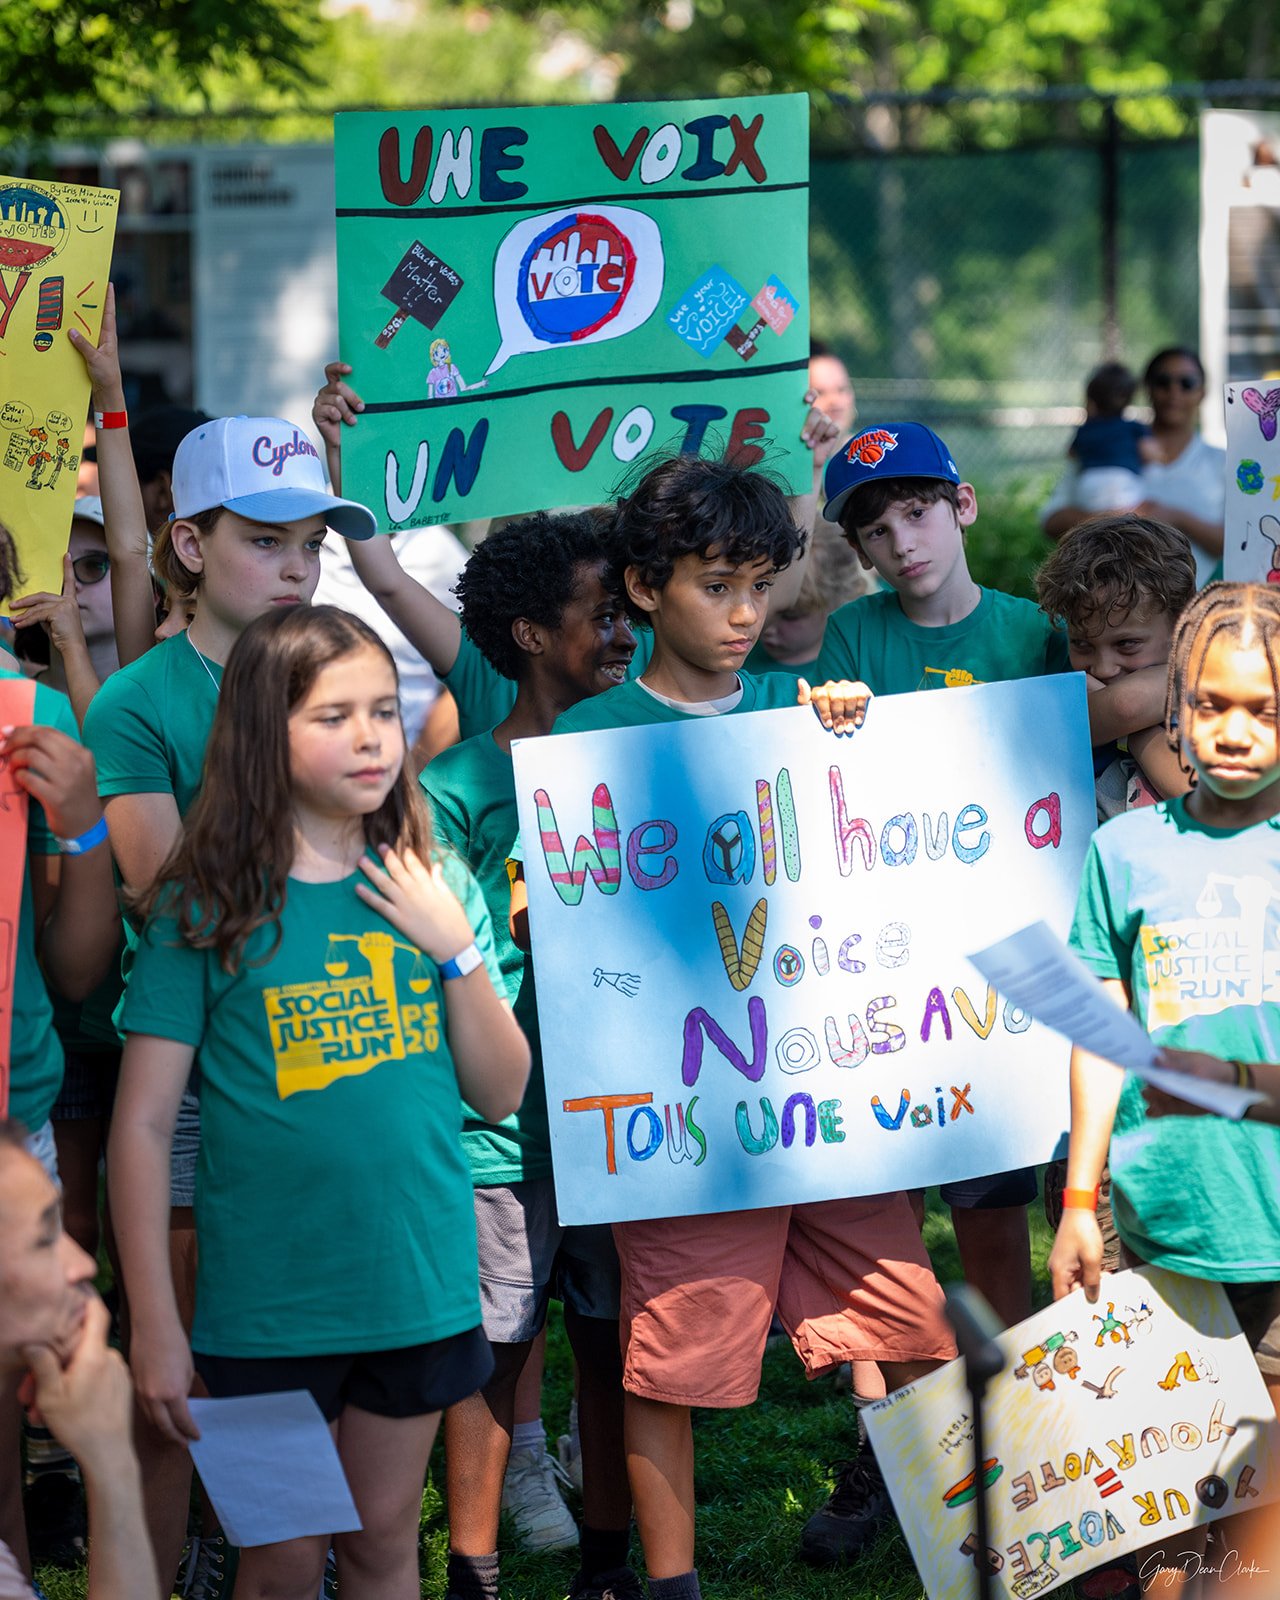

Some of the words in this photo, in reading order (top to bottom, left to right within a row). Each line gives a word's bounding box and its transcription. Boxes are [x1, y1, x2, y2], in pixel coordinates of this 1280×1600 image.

[378, 125, 529, 206] UNE
[593, 113, 767, 184] VOIX
[384, 417, 489, 524] UN
[551, 404, 771, 473] VOTE
[533, 783, 679, 906] We
[703, 767, 802, 886] all
[828, 765, 992, 878] have
[1024, 791, 1063, 849] a
[712, 897, 912, 992] Voice
[1149, 931, 1249, 956] SOCIAL
[1154, 954, 1251, 986] JUSTICE
[272, 986, 387, 1020] SOCIAL
[402, 1002, 439, 1029] PS
[1180, 979, 1251, 1000] RUN
[278, 1008, 394, 1053] JUSTICE
[320, 1033, 395, 1065] RUN
[404, 1029, 440, 1054] 20
[681, 996, 907, 1087] NOUS
[1106, 1399, 1238, 1470] YOUR
[1012, 1447, 1104, 1512] VOTE
[1132, 1465, 1259, 1526] YOUR
[1008, 1509, 1126, 1580] VOICE
